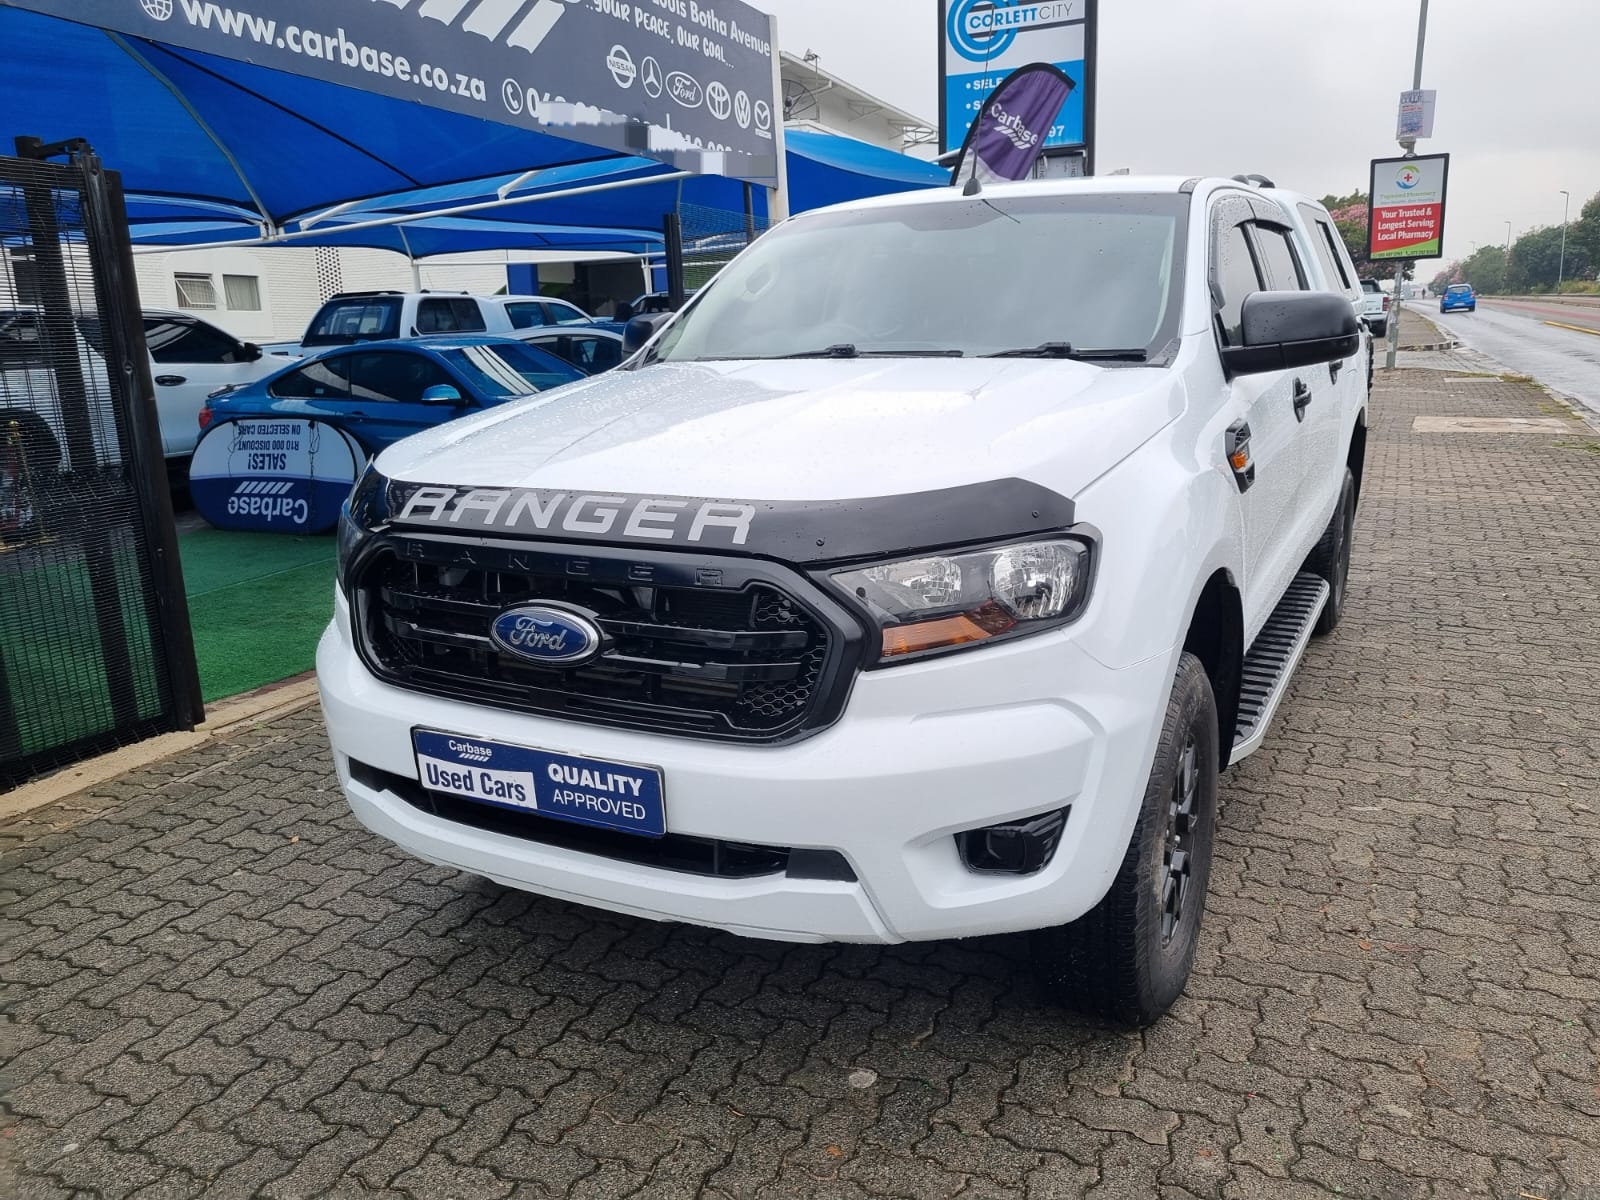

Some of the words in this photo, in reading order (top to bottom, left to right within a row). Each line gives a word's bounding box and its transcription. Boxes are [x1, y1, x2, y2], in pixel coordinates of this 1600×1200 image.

[652, 0, 687, 18] ouis
[690, 0, 727, 37] Botha
[730, 21, 771, 57] Avenue
[677, 25, 700, 52] OUR
[182, 0, 487, 102] www.carbase.co.za
[608, 59, 636, 75] NISSAN
[673, 76, 697, 101] Ford
[991, 103, 1038, 145] Carbase
[1381, 209, 1398, 219] Your
[1398, 207, 1425, 218] Trusted
[1425, 207, 1433, 216] &
[1377, 220, 1406, 231] Longest
[1407, 218, 1435, 229] Serving
[1377, 231, 1397, 241] Local
[1397, 230, 1434, 240] Pharmacy
[237, 424, 256, 436] CARS
[257, 424, 290, 435] SELECTED
[291, 424, 301, 435] ON
[237, 440, 271, 451] DISCOUNT
[271, 440, 285, 450] 000
[286, 440, 299, 450] R10
[247, 453, 287, 470] SALES!
[227, 496, 308, 524] Carbase
[399, 486, 756, 545] RANGER
[405, 541, 724, 586] RANGER
[509, 616, 568, 652] Ford
[448, 739, 492, 757] Carbase
[426, 763, 474, 792] Used
[480, 771, 527, 802] Cars
[547, 763, 643, 797] QUALITY
[553, 789, 646, 820] APPROVED
